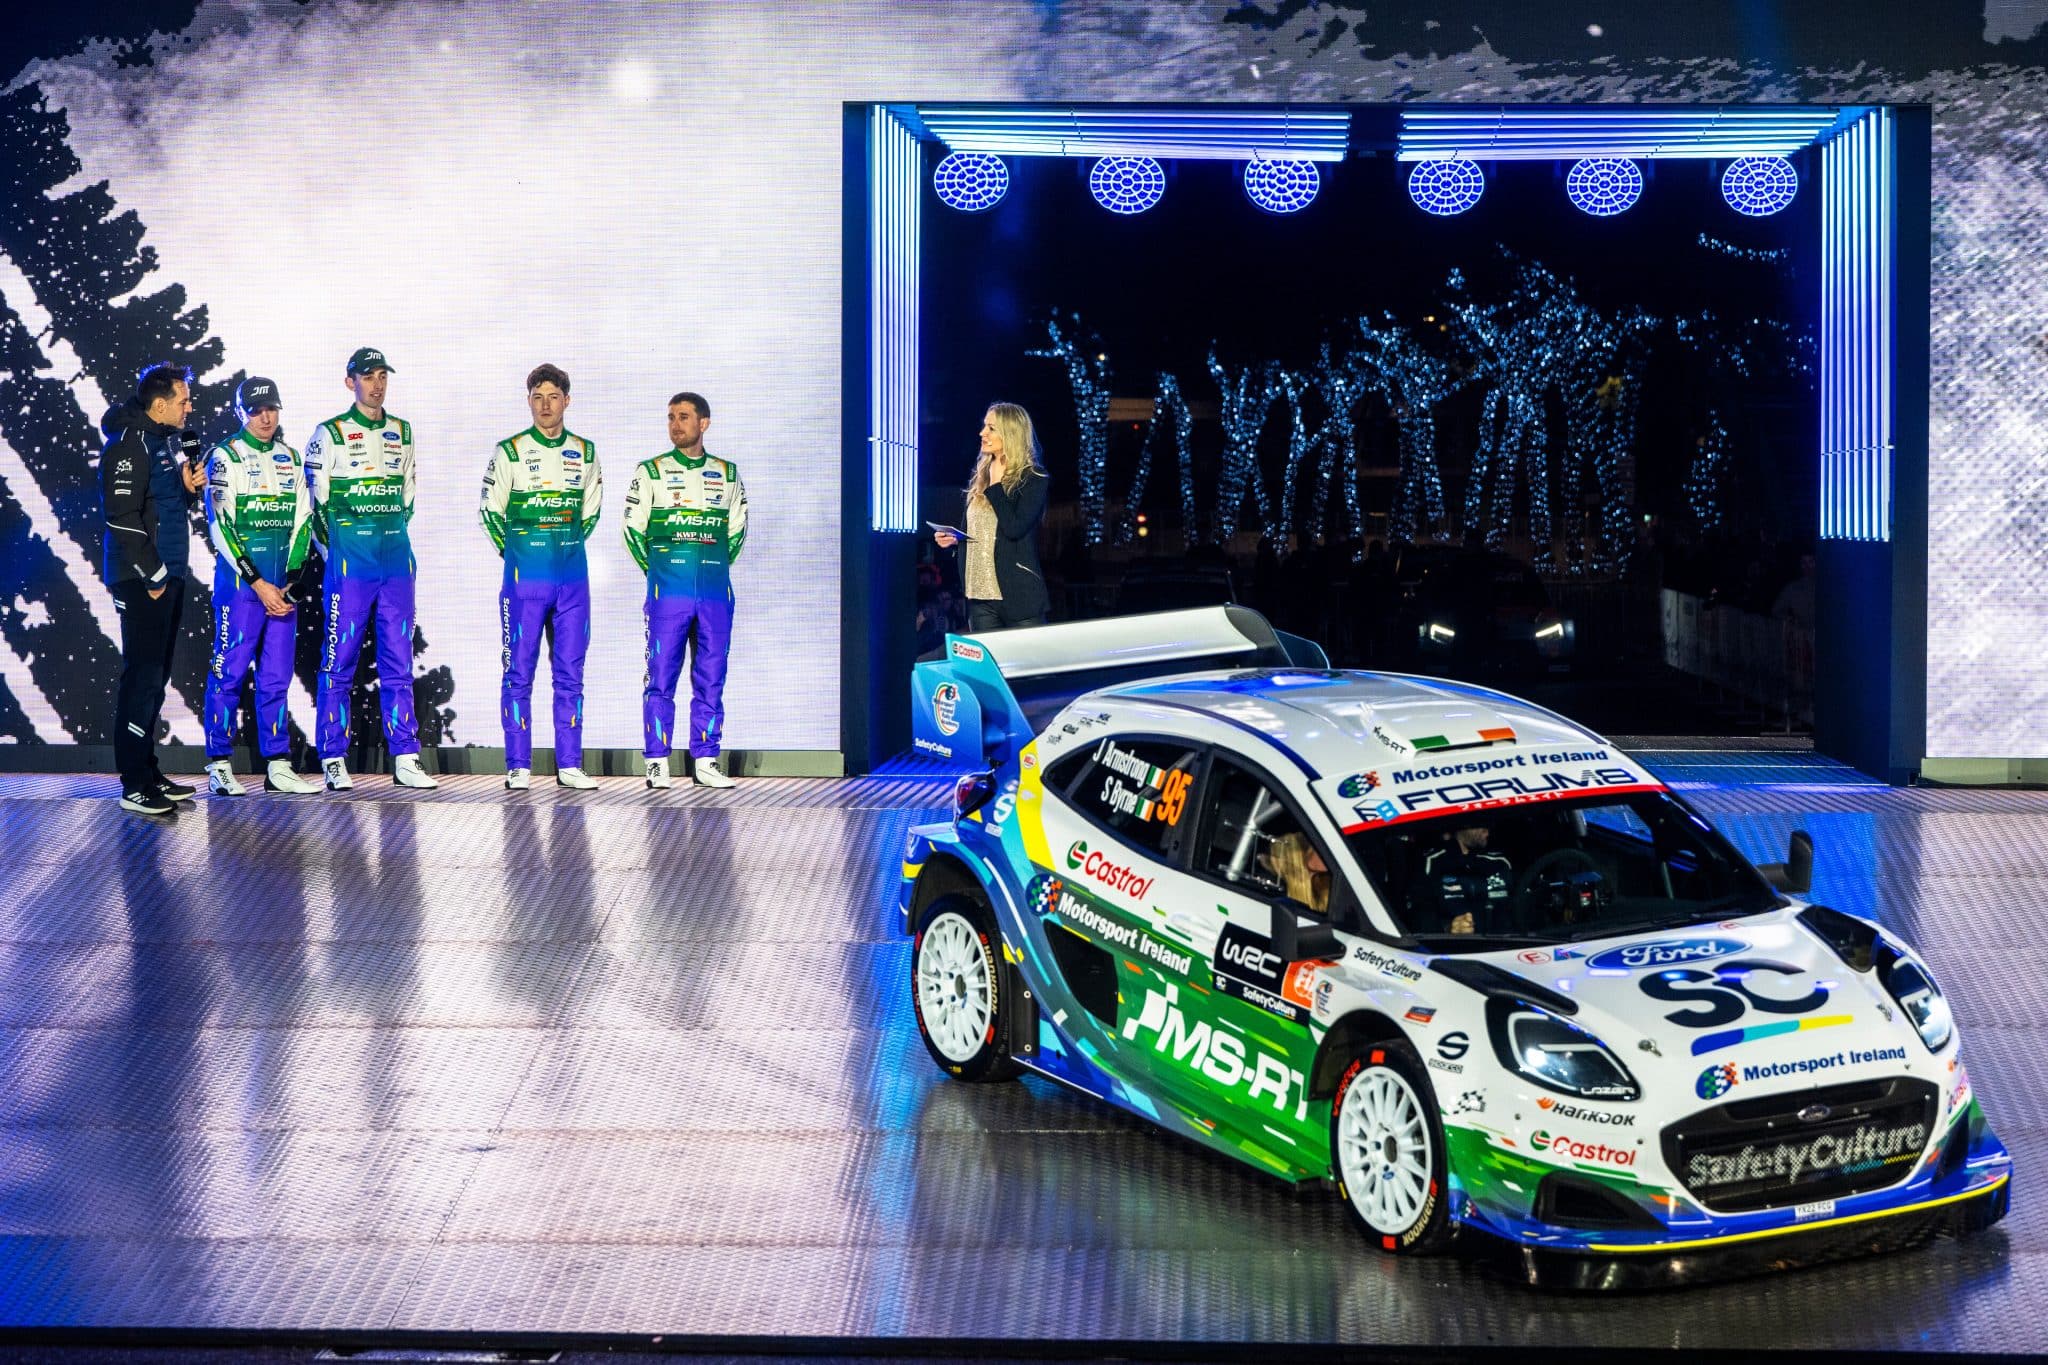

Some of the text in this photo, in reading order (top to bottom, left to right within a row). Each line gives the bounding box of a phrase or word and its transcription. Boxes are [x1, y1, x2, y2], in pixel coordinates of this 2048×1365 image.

[958, 645, 982, 659] Castrol
[1092, 737, 1150, 788] J Armstrong
[1392, 748, 1609, 785] Motorsport Ireland
[1101, 775, 1139, 813] S Byrne
[1156, 768, 1193, 826] 95
[1397, 767, 1639, 811] FORUM8
[1084, 850, 1154, 901] Castrol
[1058, 892, 1192, 976] Motorsport Ireland
[1621, 940, 1726, 967] Ford
[1222, 937, 1282, 979] WRC
[1353, 946, 1422, 983] SafetyCulture
[1242, 986, 1297, 1017] SafetyCulture
[1639, 959, 1829, 1029] SC
[1155, 1005, 1308, 1122] MS-RT
[1744, 1045, 1906, 1083] Motorsport Ireland
[1552, 1135, 1637, 1167] Castrol
[1688, 1123, 1925, 1188] SafetyCulture
